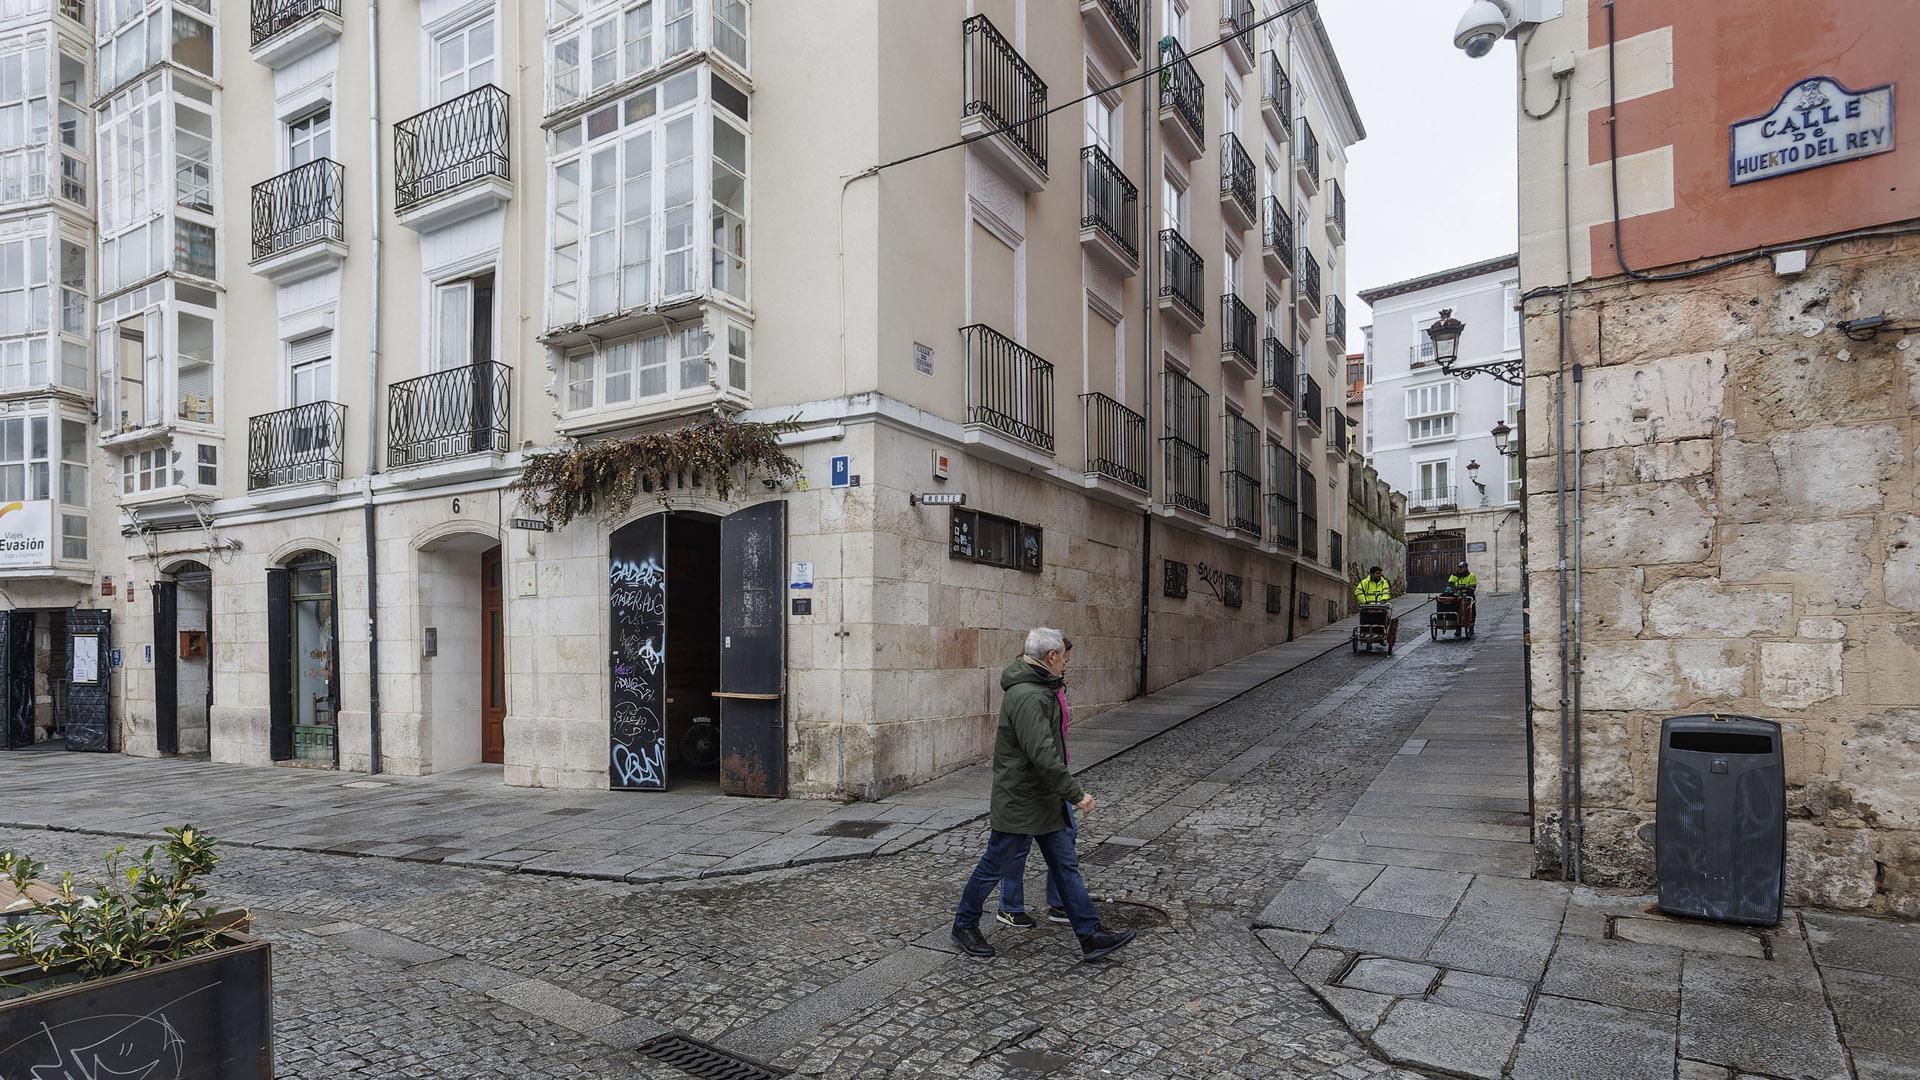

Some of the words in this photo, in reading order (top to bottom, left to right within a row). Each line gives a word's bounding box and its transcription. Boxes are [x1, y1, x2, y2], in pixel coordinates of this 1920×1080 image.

[1761, 97, 1861, 138] CALLE
[1736, 146, 1799, 176] HUERTO
[1804, 137, 1838, 160] DEL
[1846, 126, 1886, 150] REY
[836, 460, 844, 473] B
[452, 497, 460, 514] 6
[0, 537, 44, 551] Evasión
